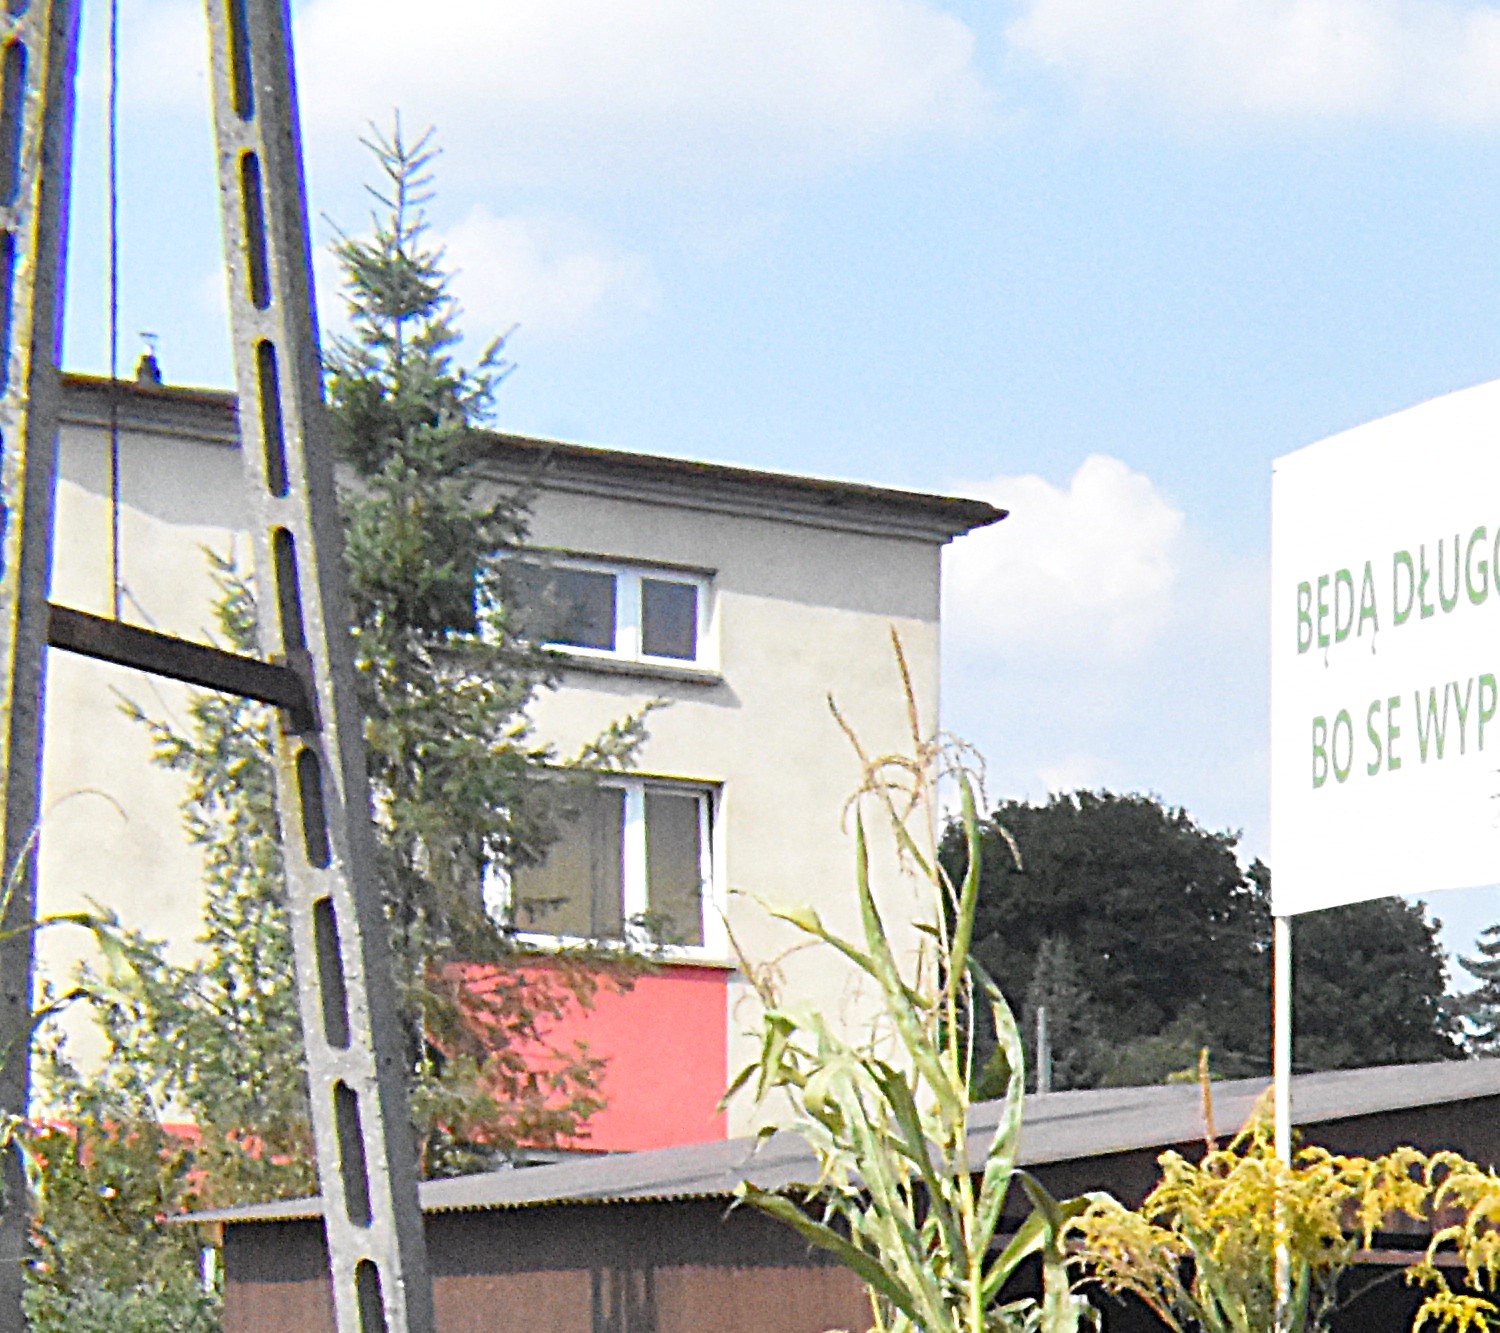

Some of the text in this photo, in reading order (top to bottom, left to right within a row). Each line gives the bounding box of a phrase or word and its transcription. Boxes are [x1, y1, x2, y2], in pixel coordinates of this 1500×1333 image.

[1297, 561, 1379, 668] BĘDĄ
[1312, 709, 1353, 789] BO
[1367, 696, 1401, 776] SE
